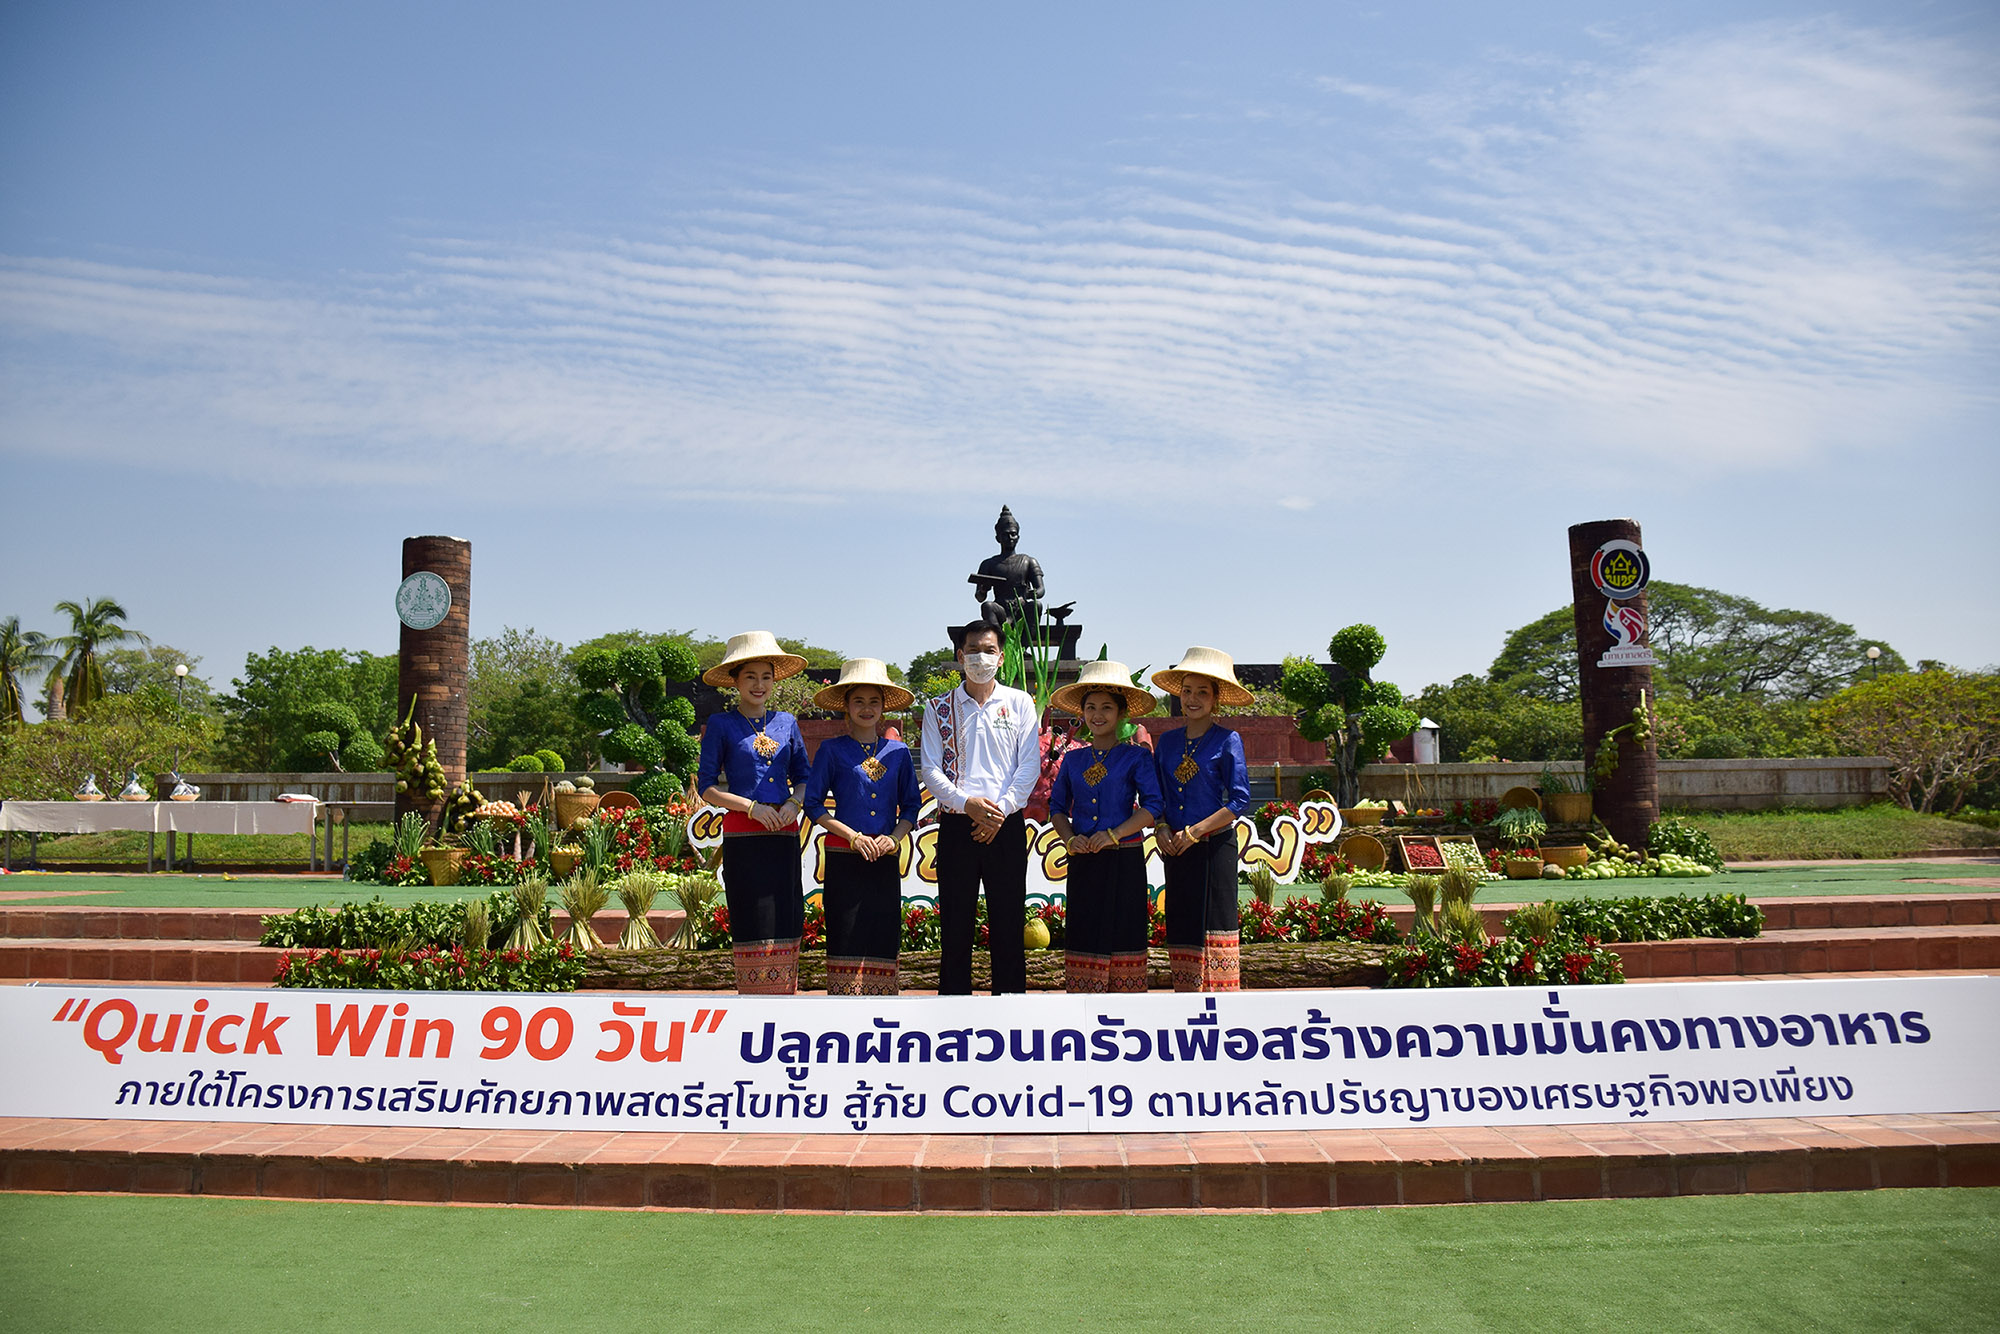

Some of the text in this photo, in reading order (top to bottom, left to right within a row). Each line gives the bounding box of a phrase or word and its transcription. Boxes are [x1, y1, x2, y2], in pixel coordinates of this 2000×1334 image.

[53, 992, 1931, 1081] “Quick Win 90 วัน” ปลูกผักสวนครัวเพื่อสร้างความมั่นคงทางอาหาร
[115, 1066, 1854, 1131] ภายใต้โครงการเสริมศักยภาพสตรีสุโขทัย สู้ภัย Covid-19 ตามหลักปรัชญาของเศรษฐกิจพอเพียง
